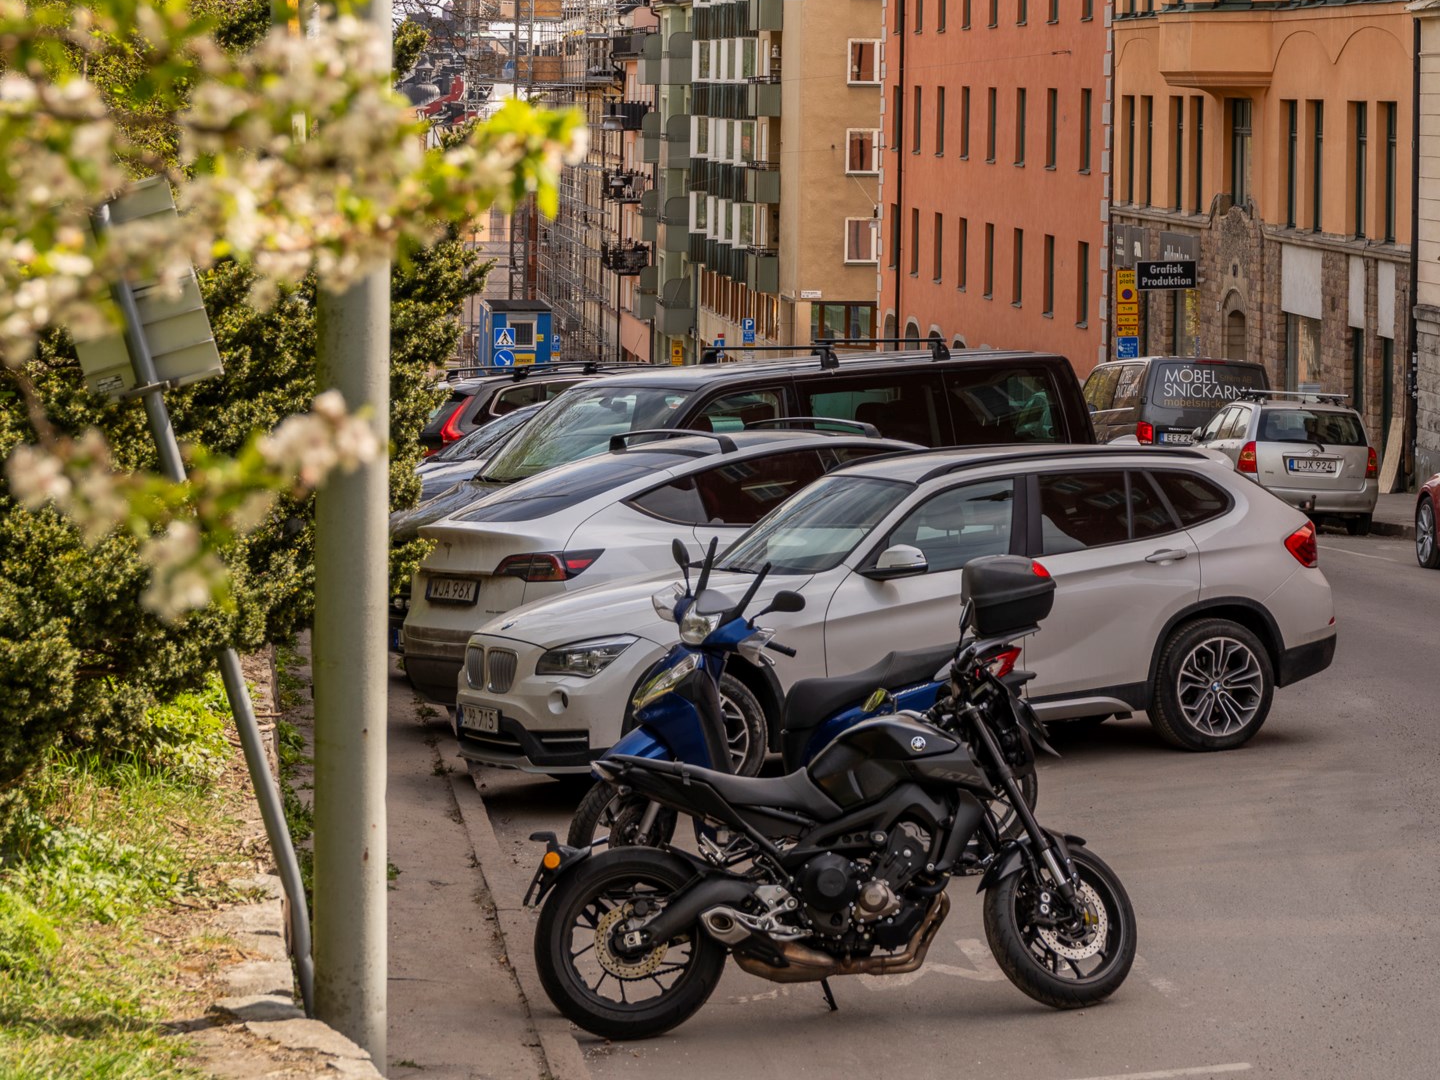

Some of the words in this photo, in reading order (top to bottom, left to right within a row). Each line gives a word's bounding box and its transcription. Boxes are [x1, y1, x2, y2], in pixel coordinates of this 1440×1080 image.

[1150, 264, 1184, 274] Grafisk
[1141, 276, 1192, 286] Produktion
[745, 319, 753, 330] P
[1164, 365, 1218, 384] MÖBEL
[1163, 383, 1250, 400] SNICKARN
[1167, 433, 1182, 442] EEZ
[1296, 460, 1314, 469] LJX
[1315, 461, 1333, 470] 924
[433, 580, 450, 597] WJA
[452, 582, 473, 599] 96X
